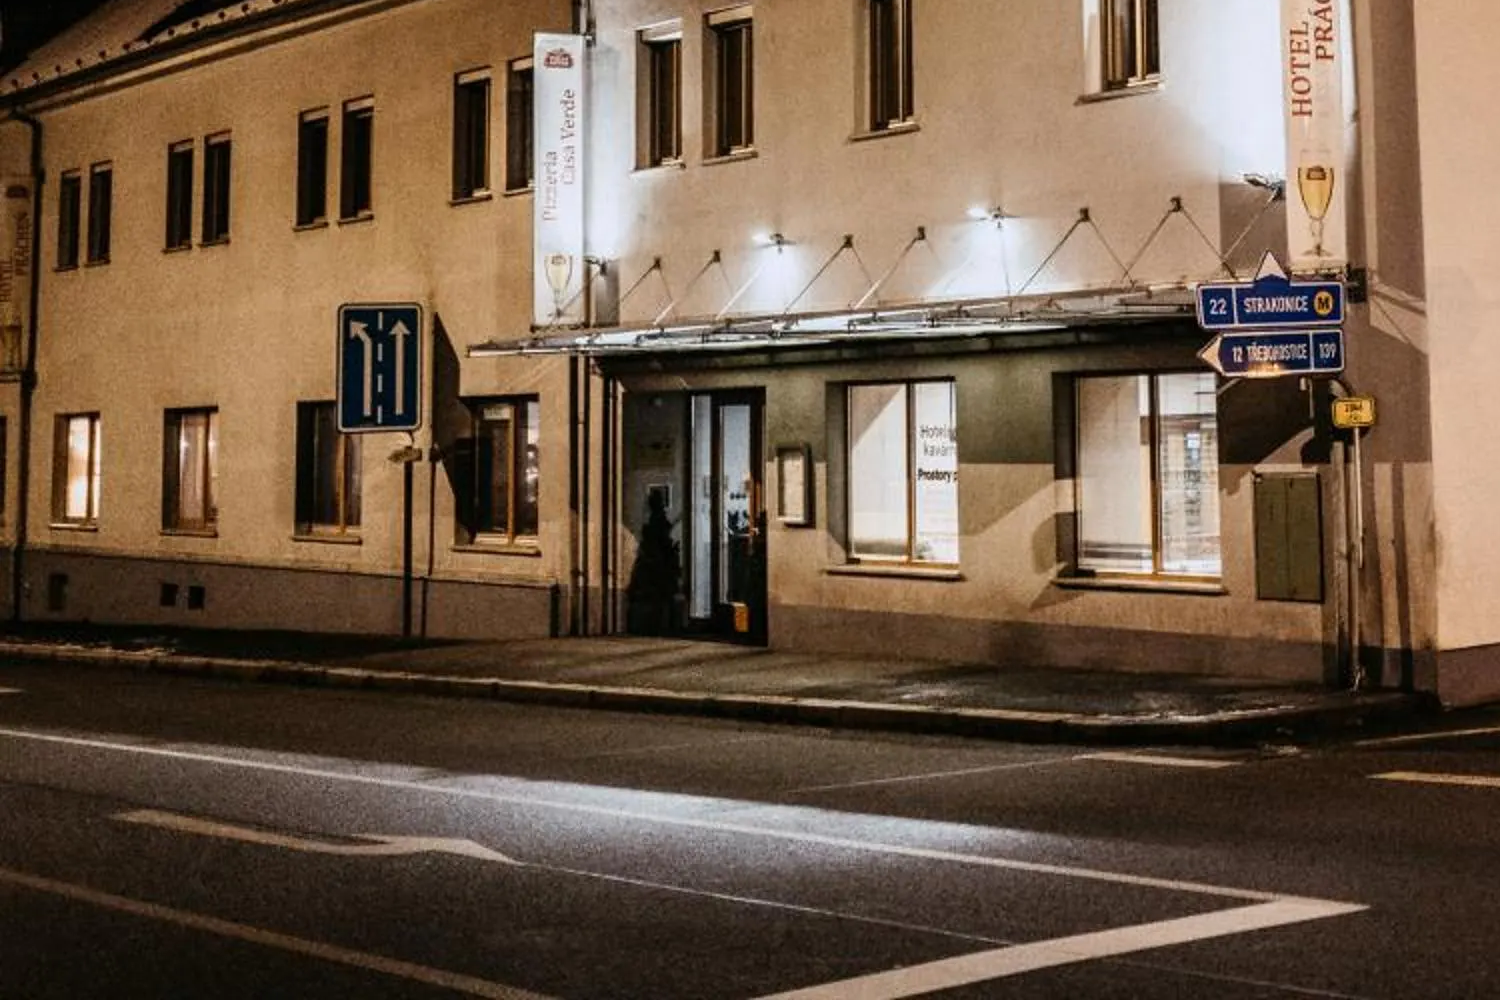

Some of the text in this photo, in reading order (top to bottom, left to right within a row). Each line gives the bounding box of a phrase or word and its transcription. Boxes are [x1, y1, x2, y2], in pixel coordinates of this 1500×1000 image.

[1289, 20, 1313, 118] HOTEL
[559, 88, 577, 144] Verde
[1209, 297, 1228, 315] 22
[1243, 295, 1309, 313] STRAKONICE
[1231, 346, 1243, 363] 12
[917, 467, 952, 483] Prostory
